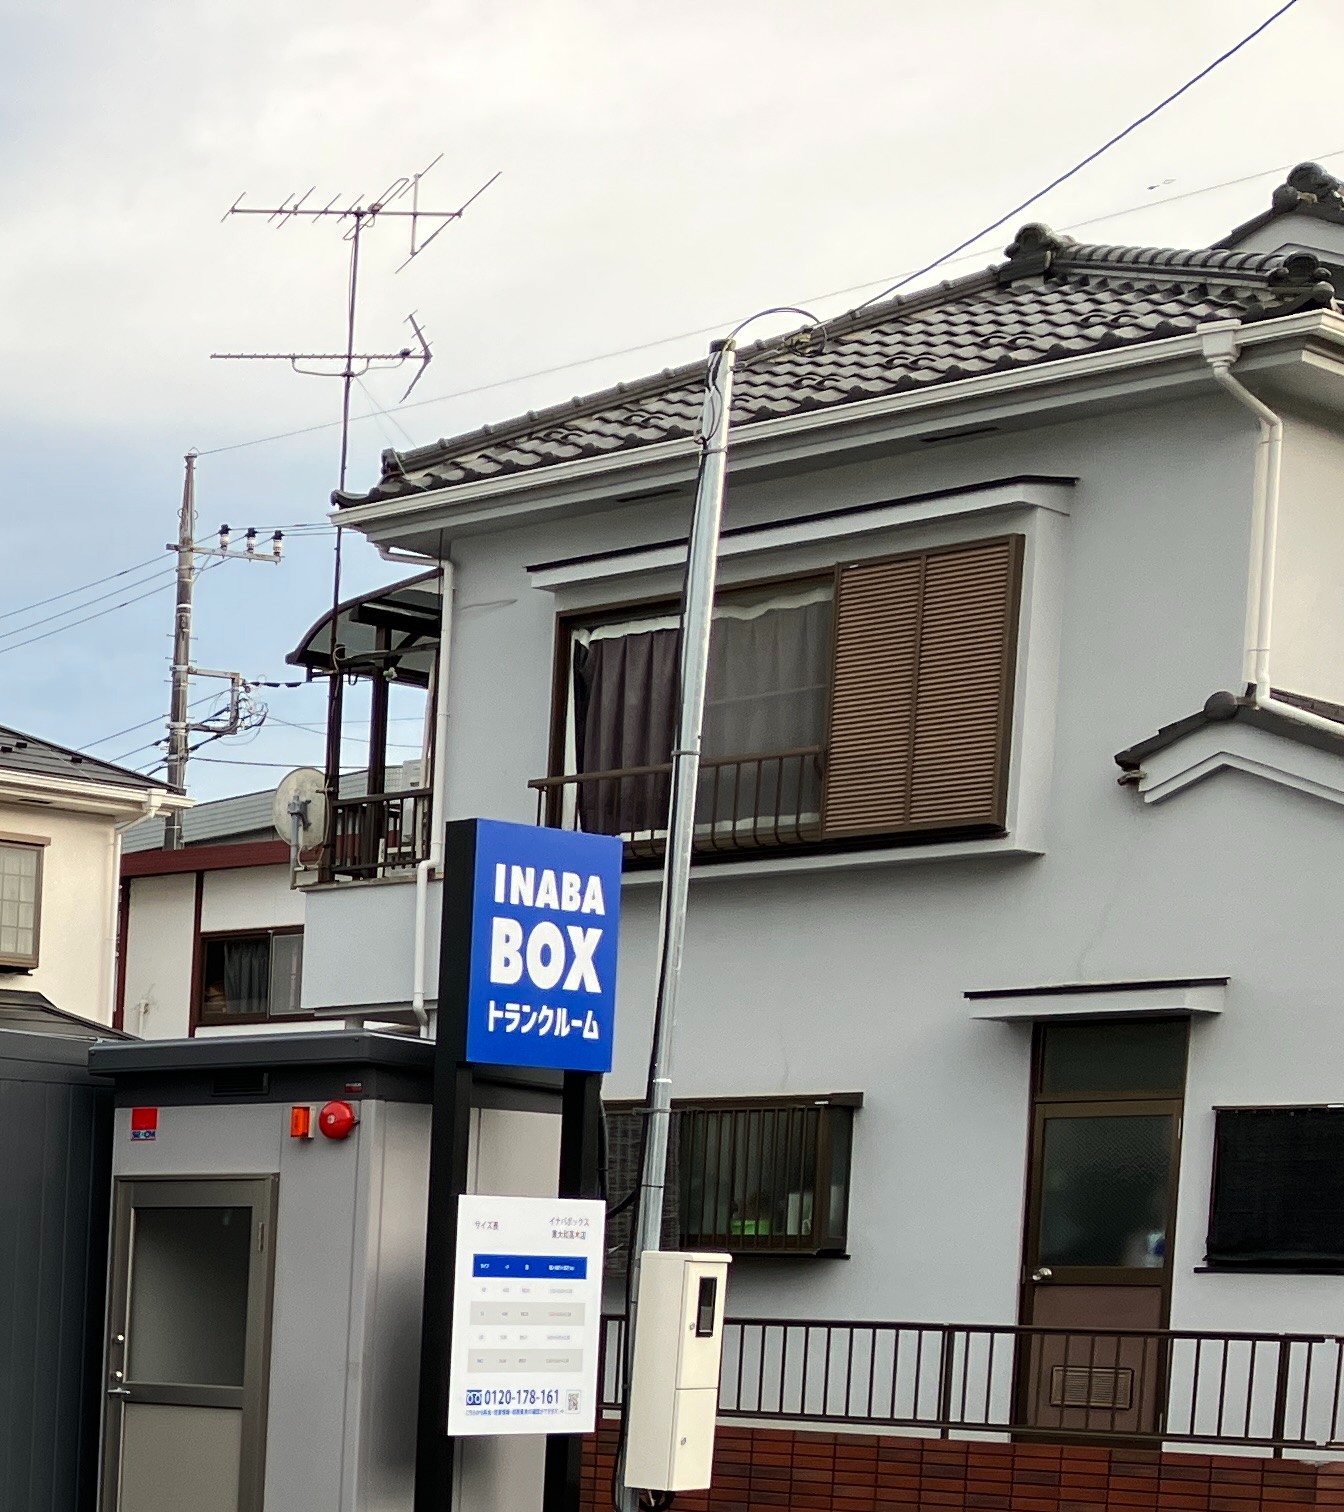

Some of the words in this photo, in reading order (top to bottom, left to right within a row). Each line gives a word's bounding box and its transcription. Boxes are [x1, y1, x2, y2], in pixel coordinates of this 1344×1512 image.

[494, 863, 605, 916] INABA
[489, 917, 602, 993] BOX
[487, 1000, 599, 1040] トランクルーム
[484, 1389, 559, 1405] 0120-178-161
